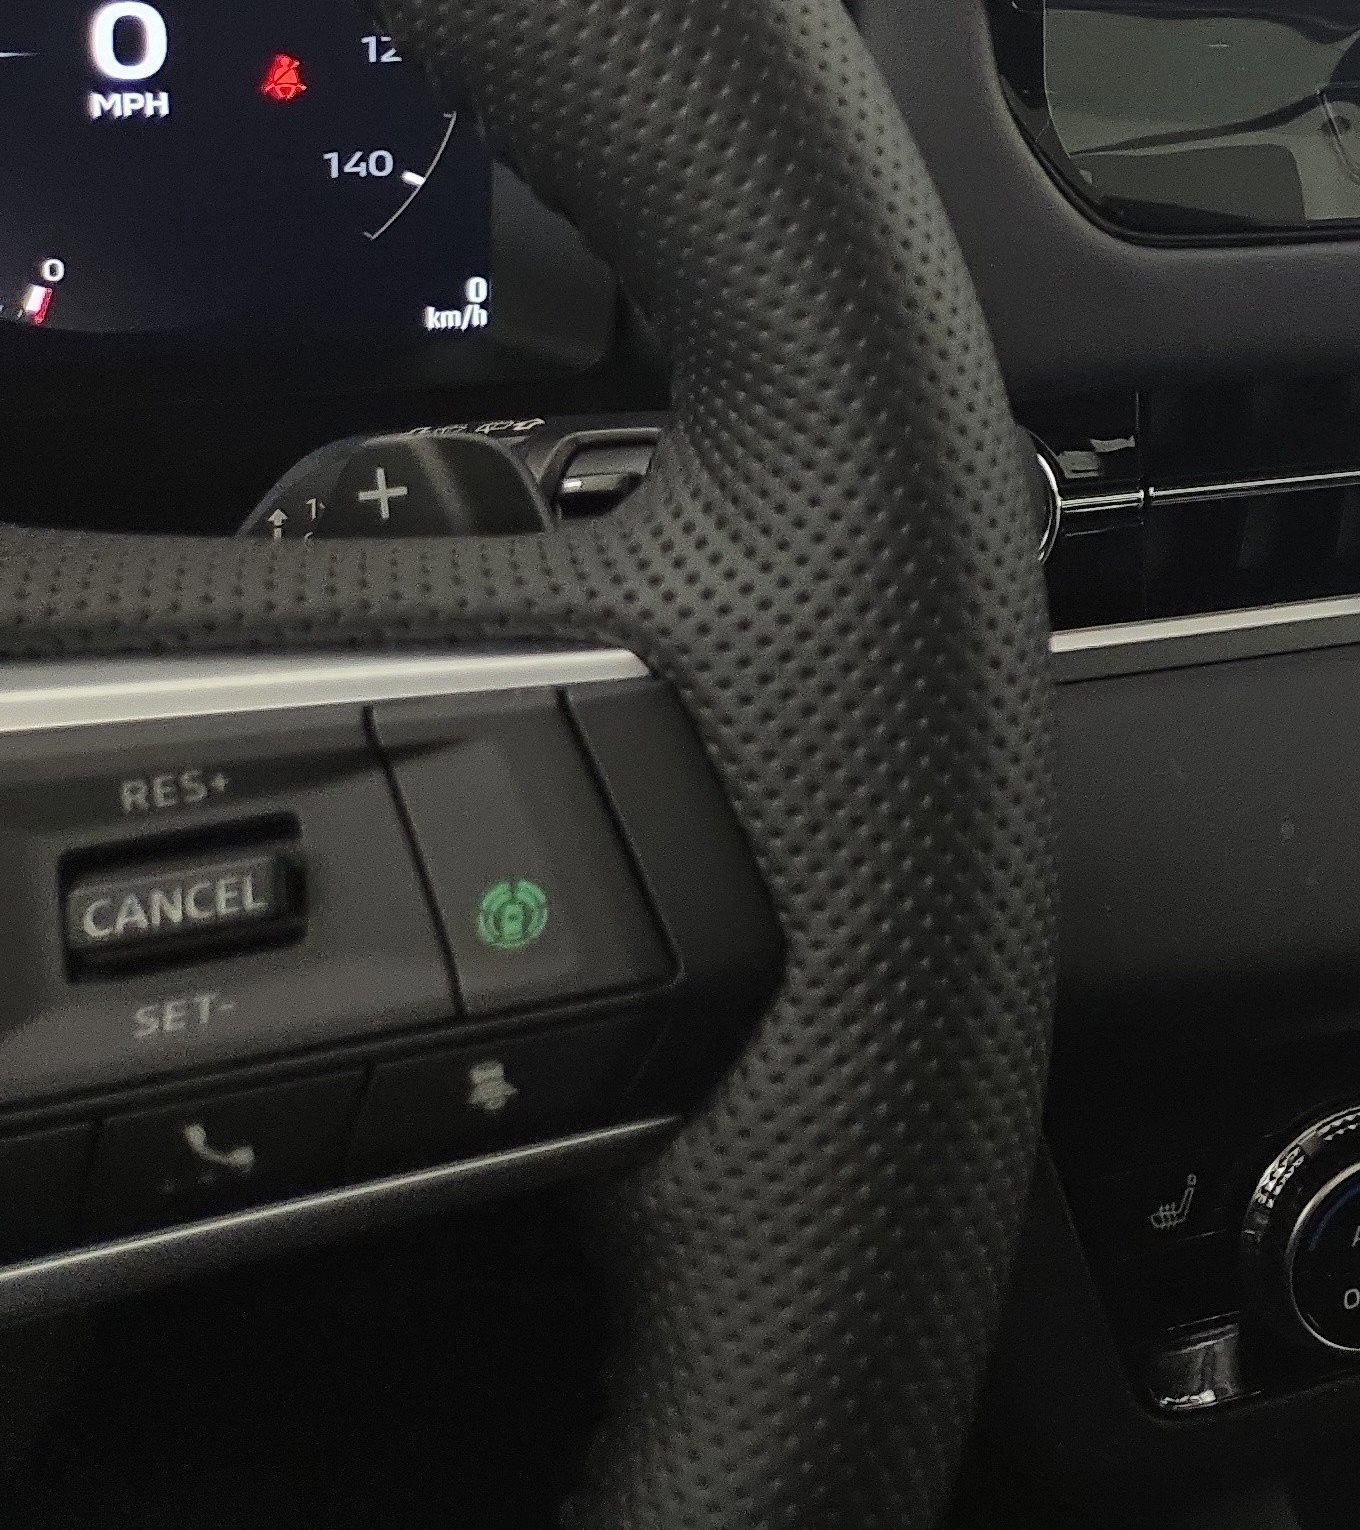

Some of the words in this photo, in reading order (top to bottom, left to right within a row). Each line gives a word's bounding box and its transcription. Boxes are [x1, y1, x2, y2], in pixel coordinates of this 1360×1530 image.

[89, 0, 169, 81] 0
[88, 91, 170, 120] MPH
[323, 150, 394, 179] 140
[41, 258, 65, 282] 0
[466, 276, 489, 304] 0
[425, 305, 489, 332] km/h
[83, 878, 270, 939] CANCEL
